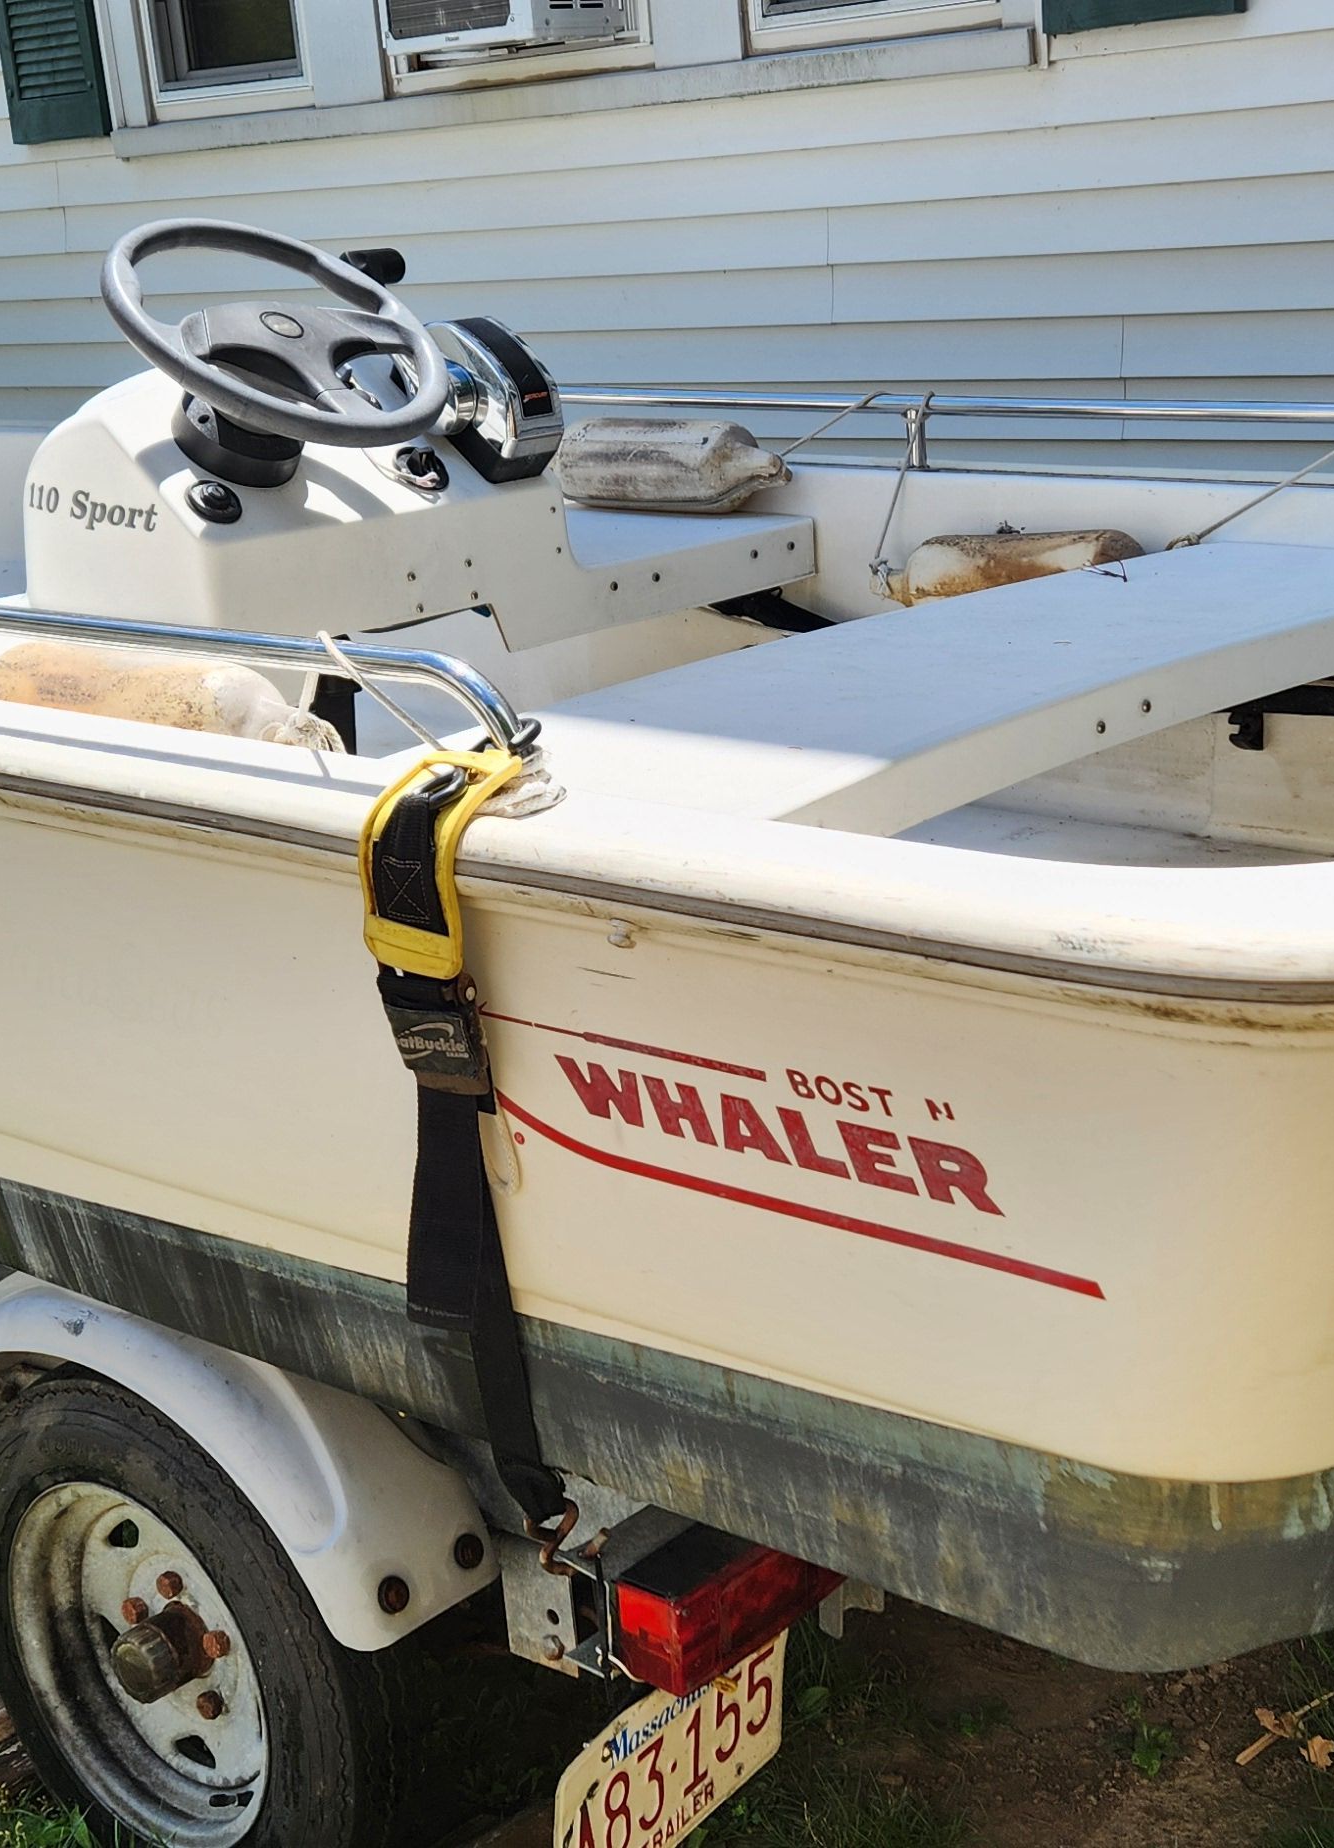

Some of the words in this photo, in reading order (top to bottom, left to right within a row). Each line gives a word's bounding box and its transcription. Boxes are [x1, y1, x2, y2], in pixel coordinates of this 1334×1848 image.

[29, 482, 60, 514] 110
[70, 490, 158, 532] Sport
[785, 1068, 956, 1121] BOSTN
[554, 1054, 1006, 1218] WHALER
